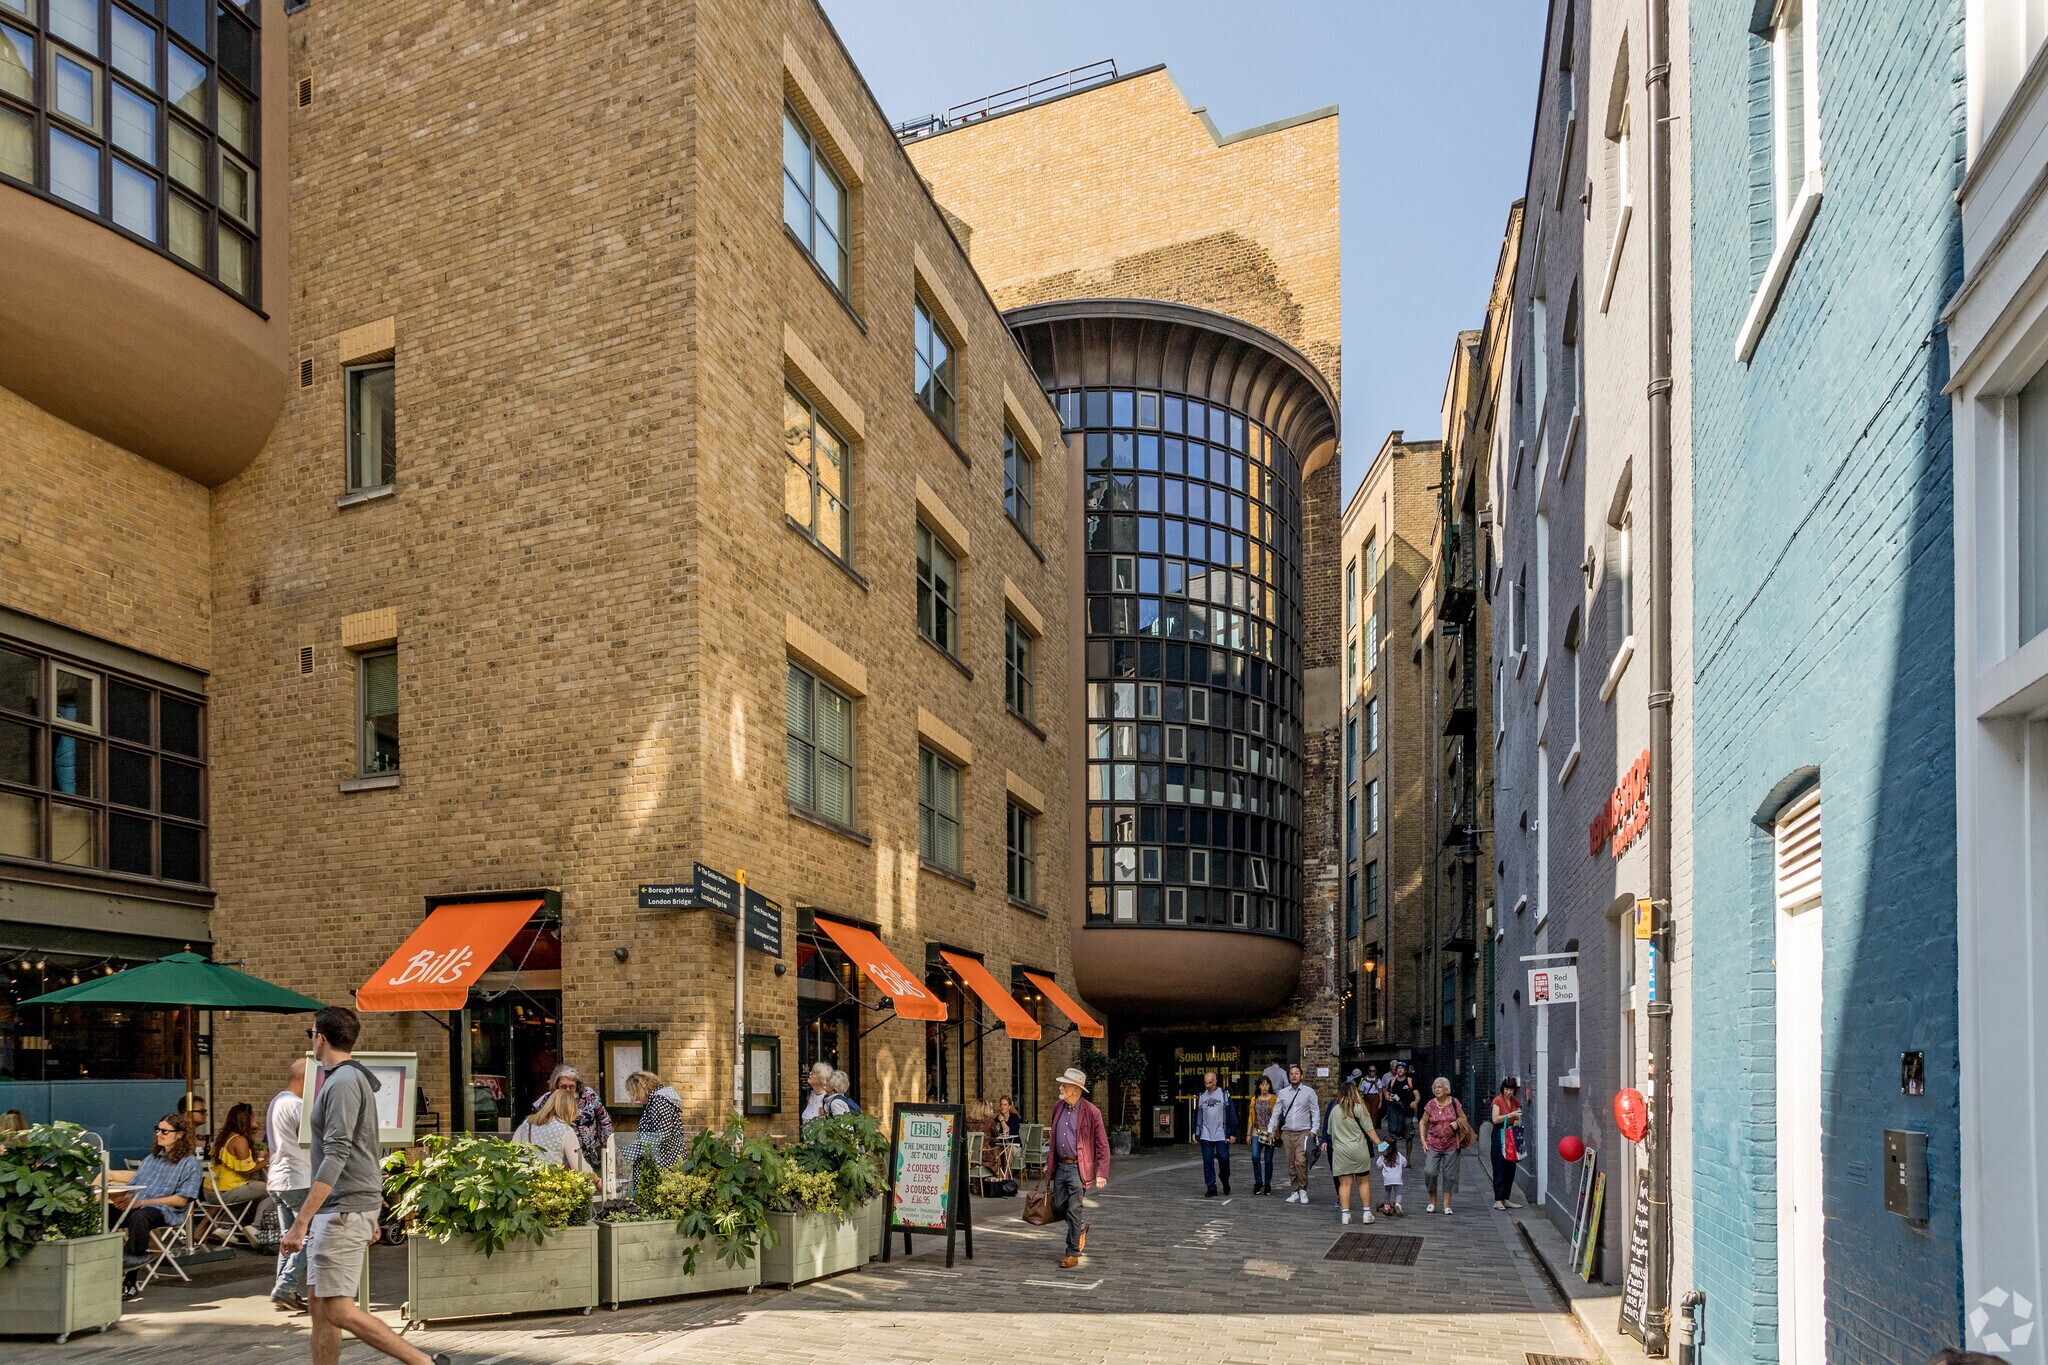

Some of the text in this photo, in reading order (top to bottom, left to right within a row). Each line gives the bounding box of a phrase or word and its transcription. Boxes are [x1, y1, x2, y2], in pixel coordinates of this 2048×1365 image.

[1621, 749, 1650, 816] SHOP
[648, 887, 674, 895] Borough
[672, 898, 692, 906] Bridge
[701, 893, 713, 903] London
[389, 945, 473, 985] Bill's
[866, 962, 926, 998] Bill's
[1554, 973, 1568, 981] Red
[1554, 983, 1567, 991] Bus
[1554, 991, 1574, 1000] Shop
[1179, 1052, 1238, 1062] SOHO WHARF
[913, 1121, 940, 1138] Bill's
[904, 1142, 947, 1152] THE INCREDIBLE
[910, 1151, 938, 1160] SET MENU
[907, 1163, 940, 1174] 2 COURSES
[912, 1173, 932, 1183] £13.95
[904, 1184, 939, 1195] 3 COURSES
